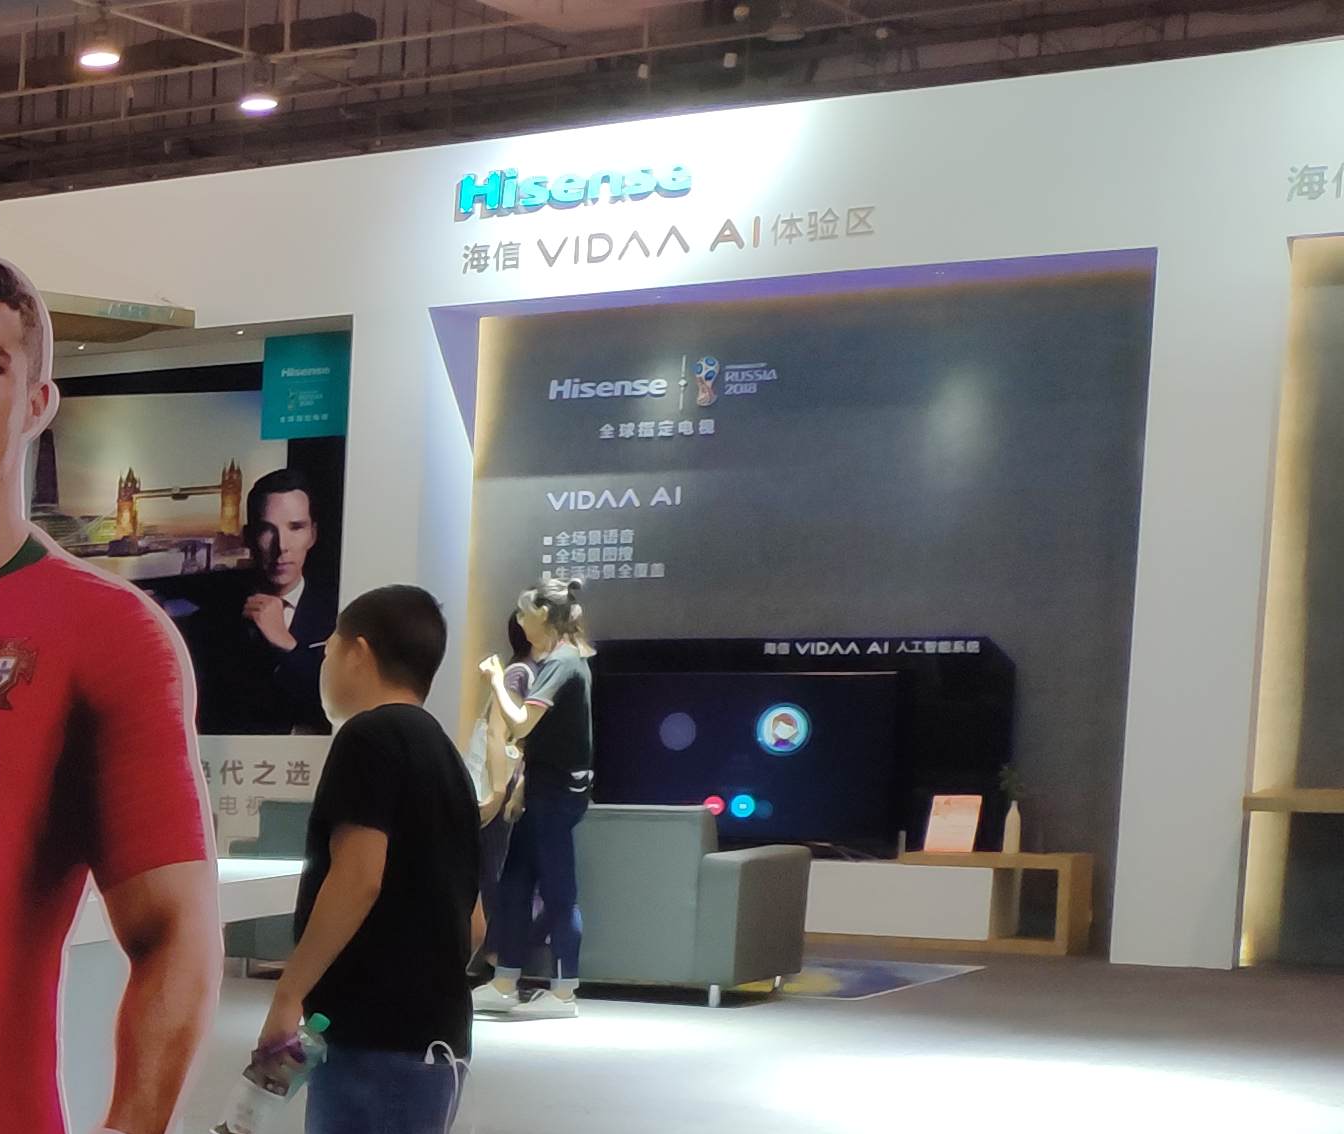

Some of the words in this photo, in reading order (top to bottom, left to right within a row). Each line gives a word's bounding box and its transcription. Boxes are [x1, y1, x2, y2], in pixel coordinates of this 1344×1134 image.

[455, 163, 693, 221] Hisense
[462, 240, 521, 274] 海信
[709, 215, 760, 252] AI
[770, 206, 876, 247] 体验区
[723, 368, 778, 383] RUSSIA
[548, 377, 669, 401] Hisense
[599, 418, 716, 439] 全球指定电视
[650, 486, 682, 506] AI
[866, 641, 889, 655] AI
